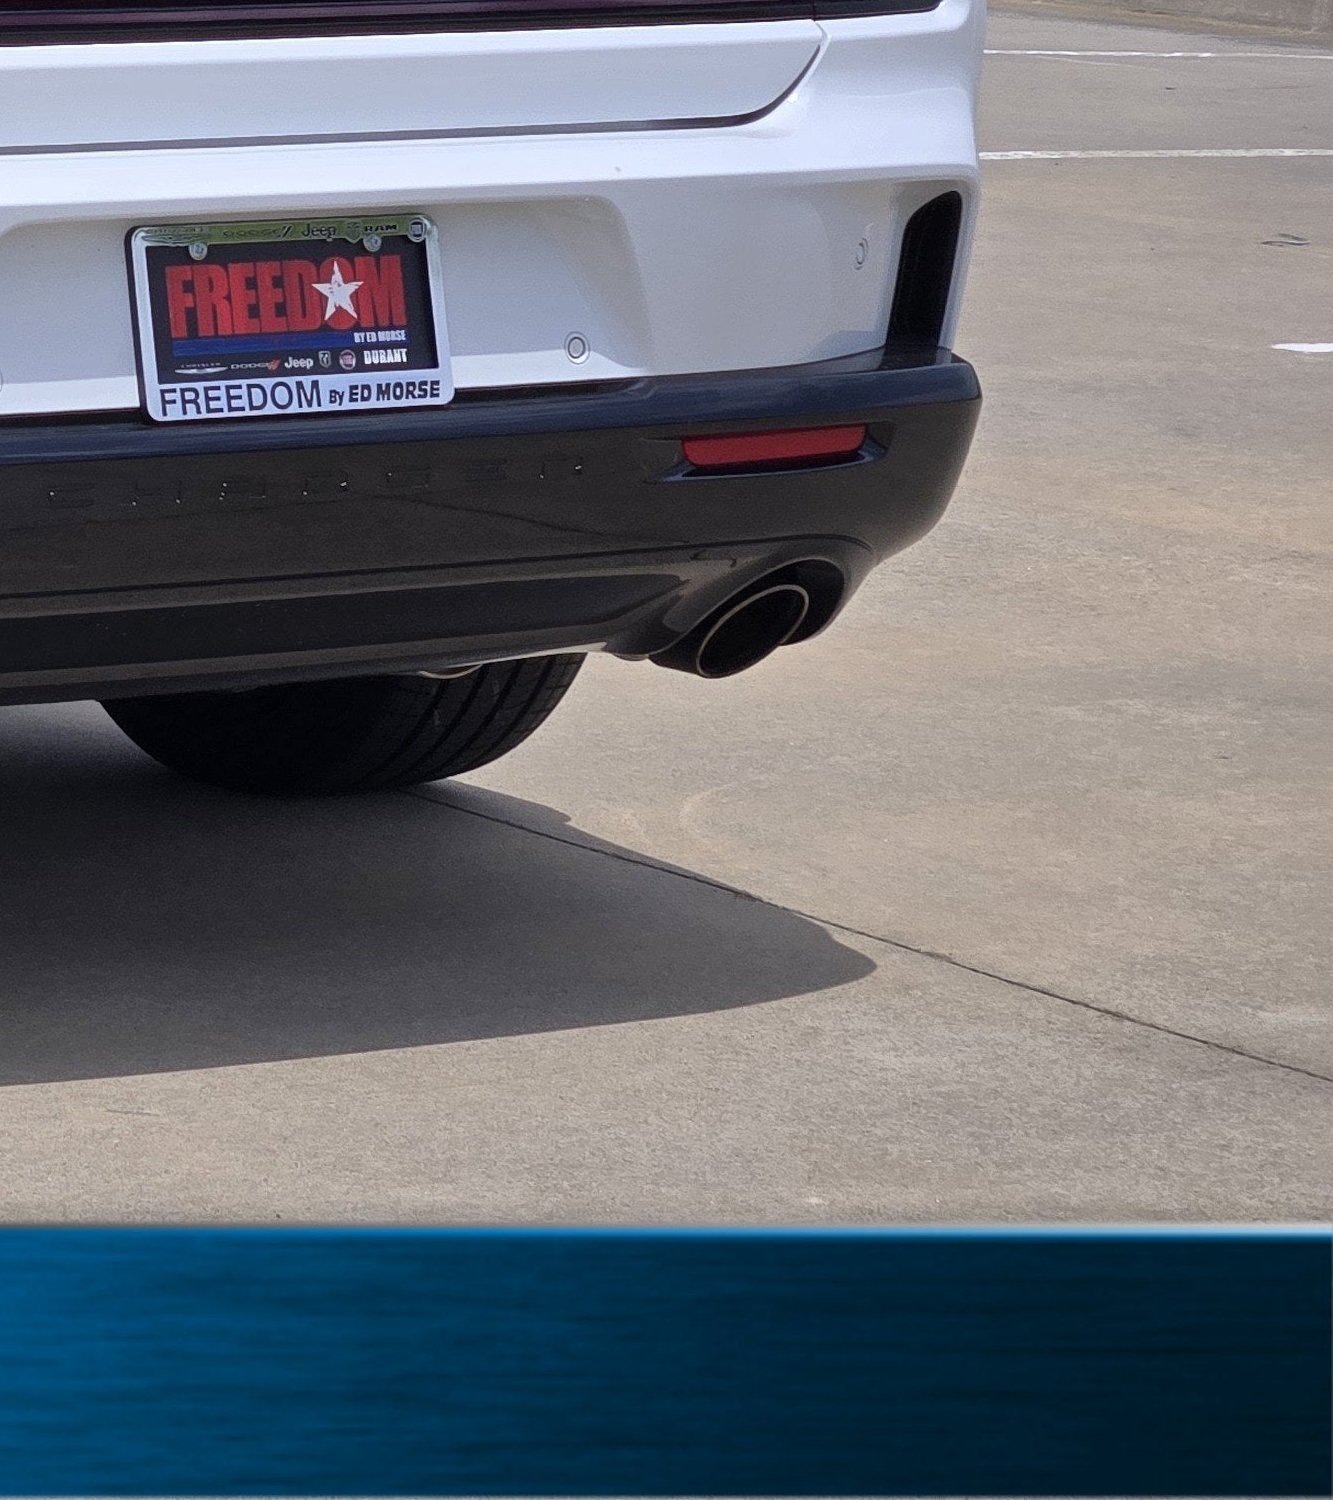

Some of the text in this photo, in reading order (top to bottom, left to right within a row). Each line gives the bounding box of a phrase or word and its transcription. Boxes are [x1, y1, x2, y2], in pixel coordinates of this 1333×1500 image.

[301, 223, 336, 238] Jeep
[364, 223, 397, 232] RAM
[165, 254, 408, 338] FREEDOM
[353, 329, 407, 343] BY ED MORSE
[284, 356, 314, 370] Jeep
[363, 348, 408, 365] DURANT
[159, 380, 322, 417] FREEDOM
[348, 383, 372, 403] ED
[376, 380, 440, 401] MORSE
